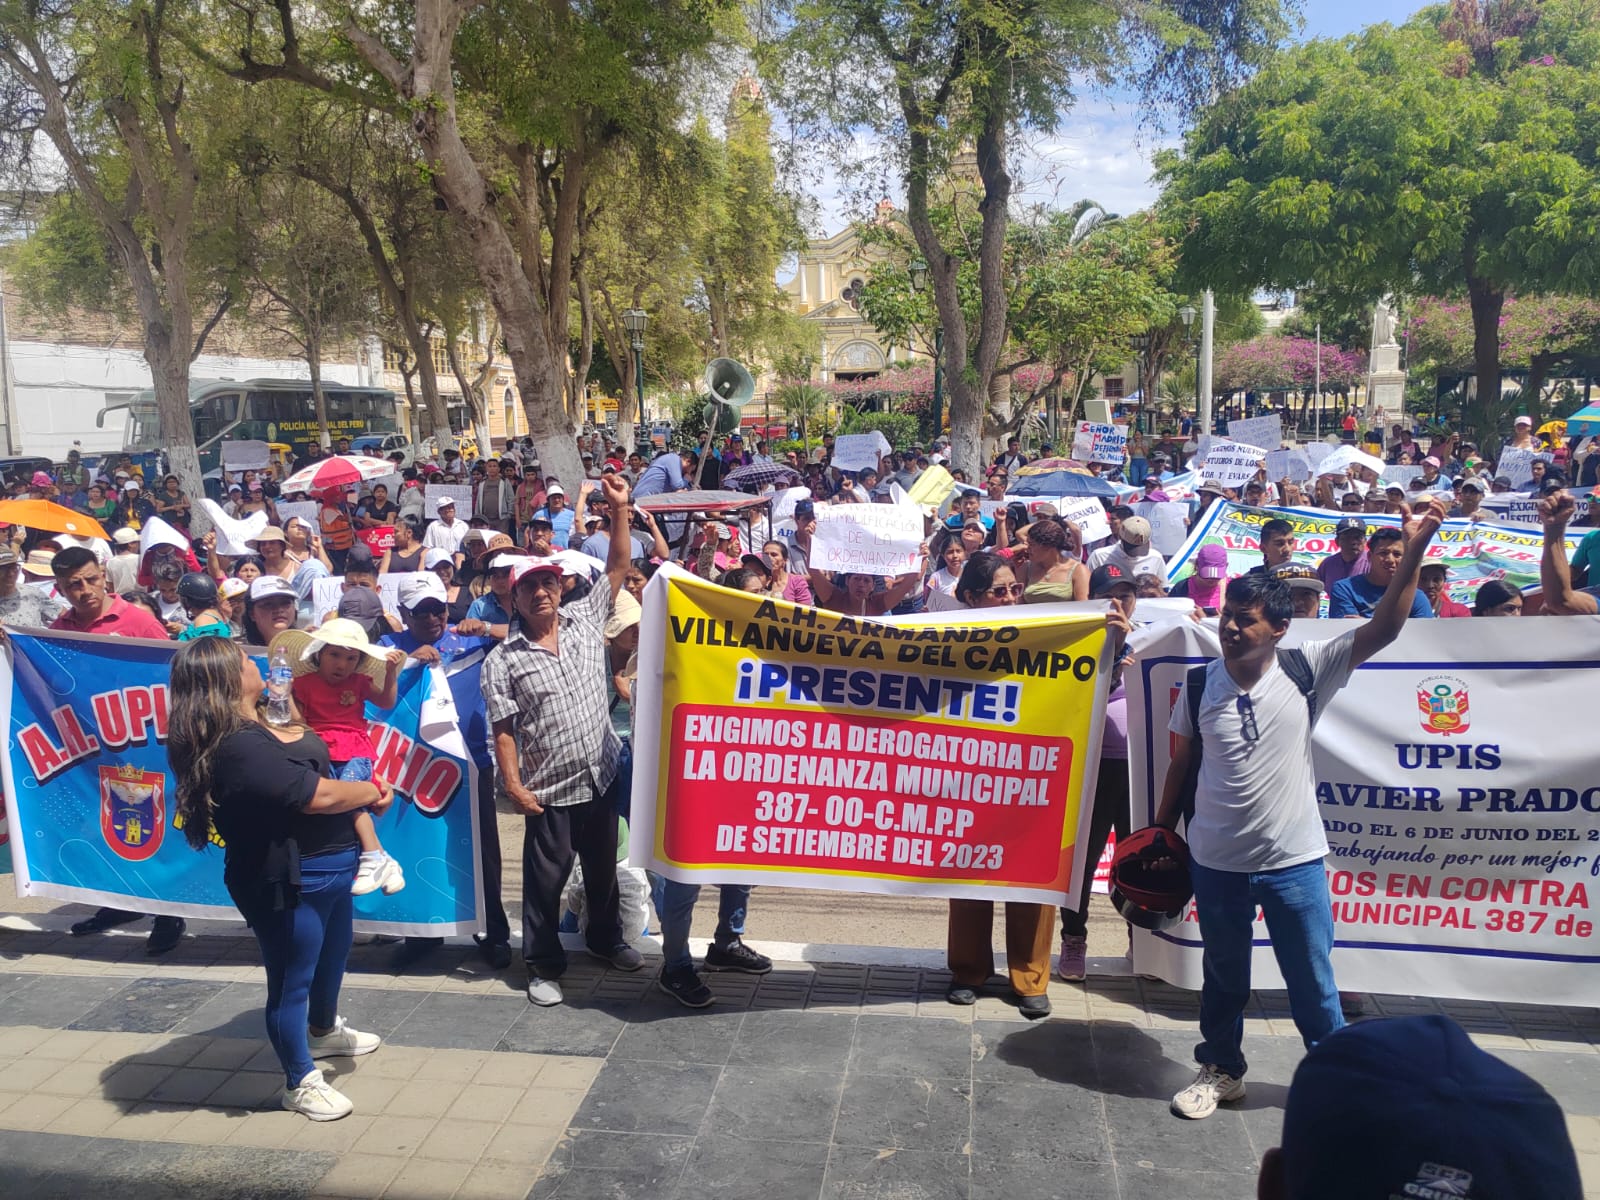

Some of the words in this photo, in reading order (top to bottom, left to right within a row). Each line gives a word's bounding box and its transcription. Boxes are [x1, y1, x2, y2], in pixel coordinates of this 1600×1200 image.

[1206, 457, 1233, 465] STUDIOS
[848, 530, 864, 544] DE
[753, 598, 826, 630] A.H.
[833, 615, 1020, 644] ARMANDO
[669, 615, 885, 660] VILLANUEVA
[896, 643, 957, 668] DEL
[963, 645, 1096, 682] CAMPO
[737, 661, 1020, 723] ¡PRESENTE!
[684, 714, 808, 748] EXIGIMOS
[812, 721, 842, 751] LA
[847, 724, 1023, 771] DEROGATORIA
[1028, 745, 1060, 772] DE
[1394, 743, 1502, 771] UPIS
[683, 749, 717, 781] LA
[723, 750, 889, 792] ORDENANZA
[895, 763, 1050, 806] MUNICIPAL
[716, 824, 748, 852] DE
[752, 825, 888, 862] SETIEMBRE
[892, 836, 935, 867] DEL
[940, 842, 1004, 870] 2023
[1369, 823, 1397, 837] EL
[1405, 827, 1416, 839] 6
[1423, 827, 1454, 840] DE
[1460, 828, 1529, 841] JUNIO
[1536, 828, 1580, 841] DEL
[1440, 845, 1483, 870] por
[1488, 854, 1517, 866] un
[1521, 850, 1588, 874] mejor
[1386, 873, 1432, 899] EN
[1440, 876, 1589, 909] CONTRA
[1484, 908, 1548, 934] 387
[1554, 913, 1593, 938] de
